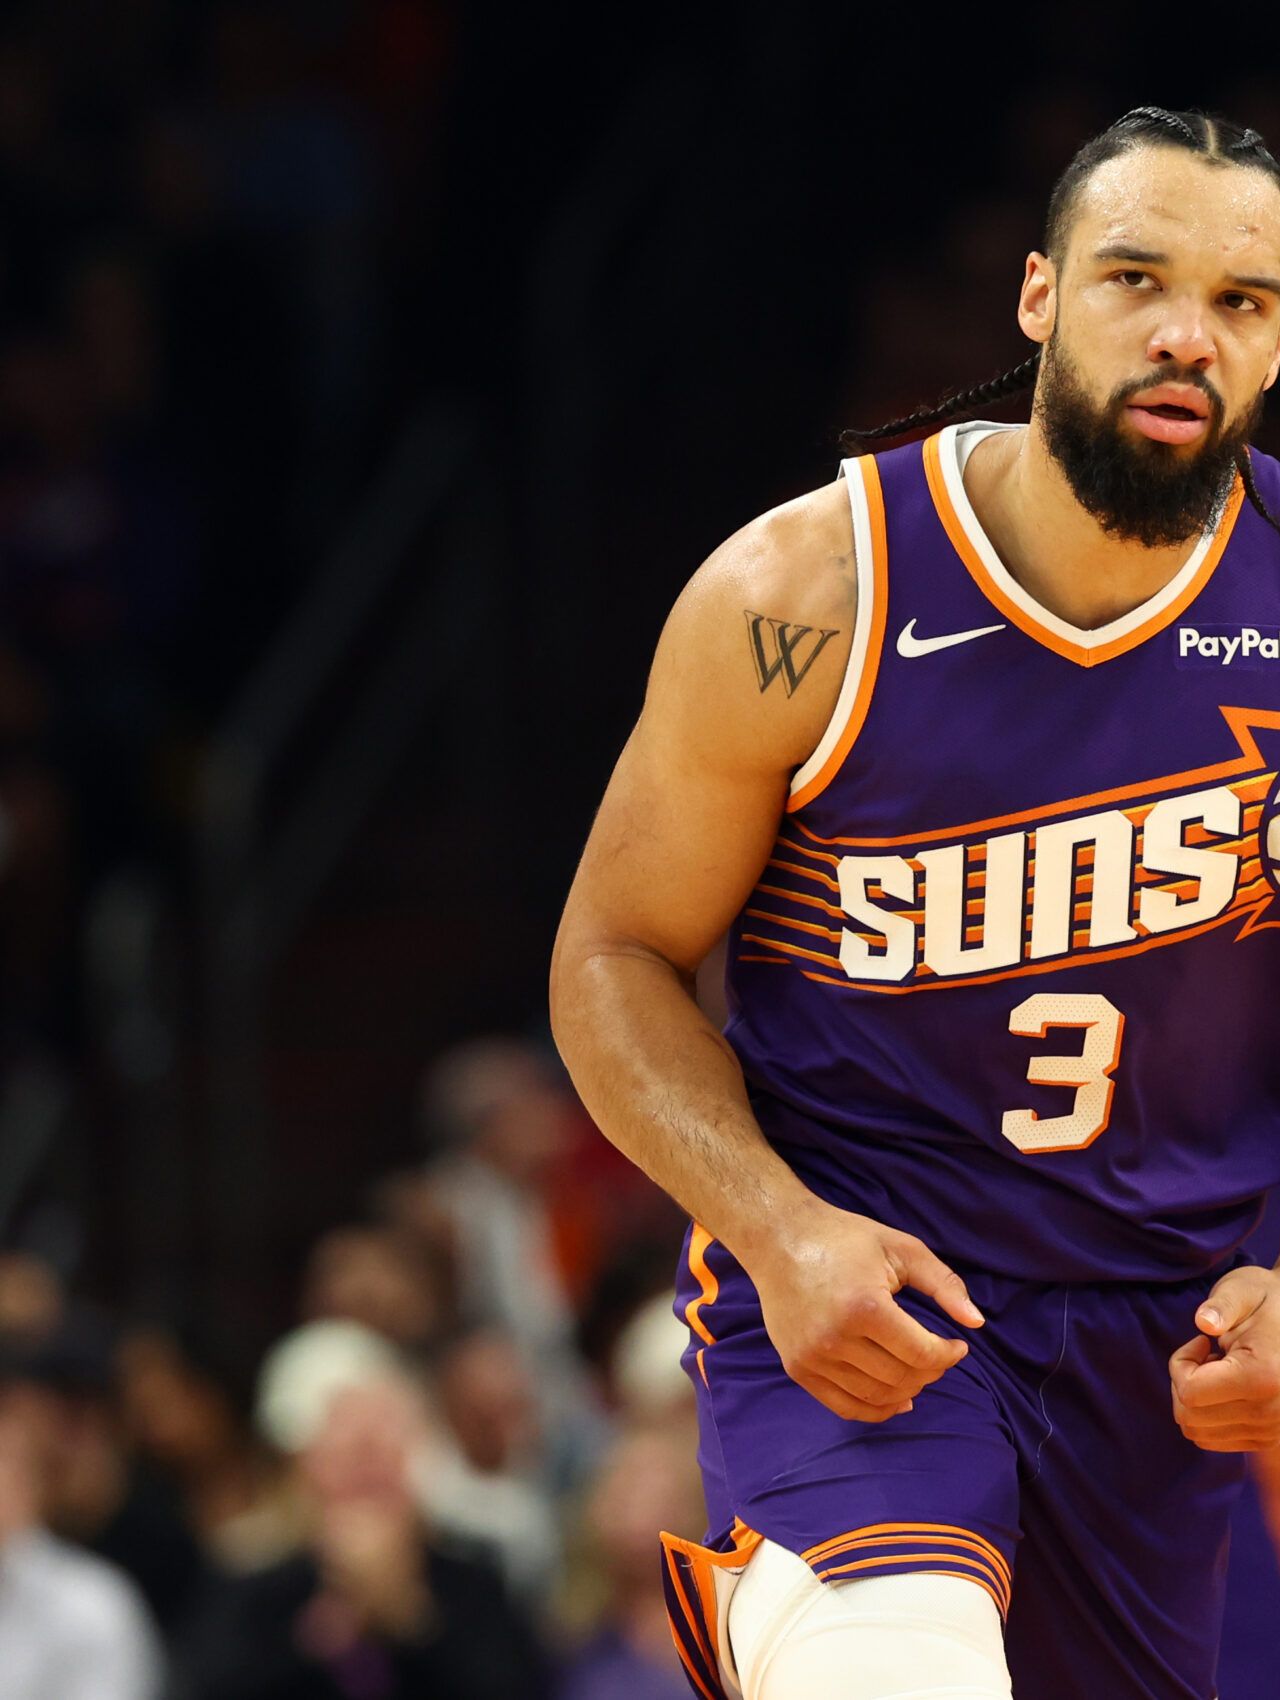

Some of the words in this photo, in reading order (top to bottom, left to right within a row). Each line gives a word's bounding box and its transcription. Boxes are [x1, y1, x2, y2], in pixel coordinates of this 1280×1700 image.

[743, 609, 841, 699] W
[836, 785, 1241, 982] SUNS
[1001, 992, 1125, 1154] 3
